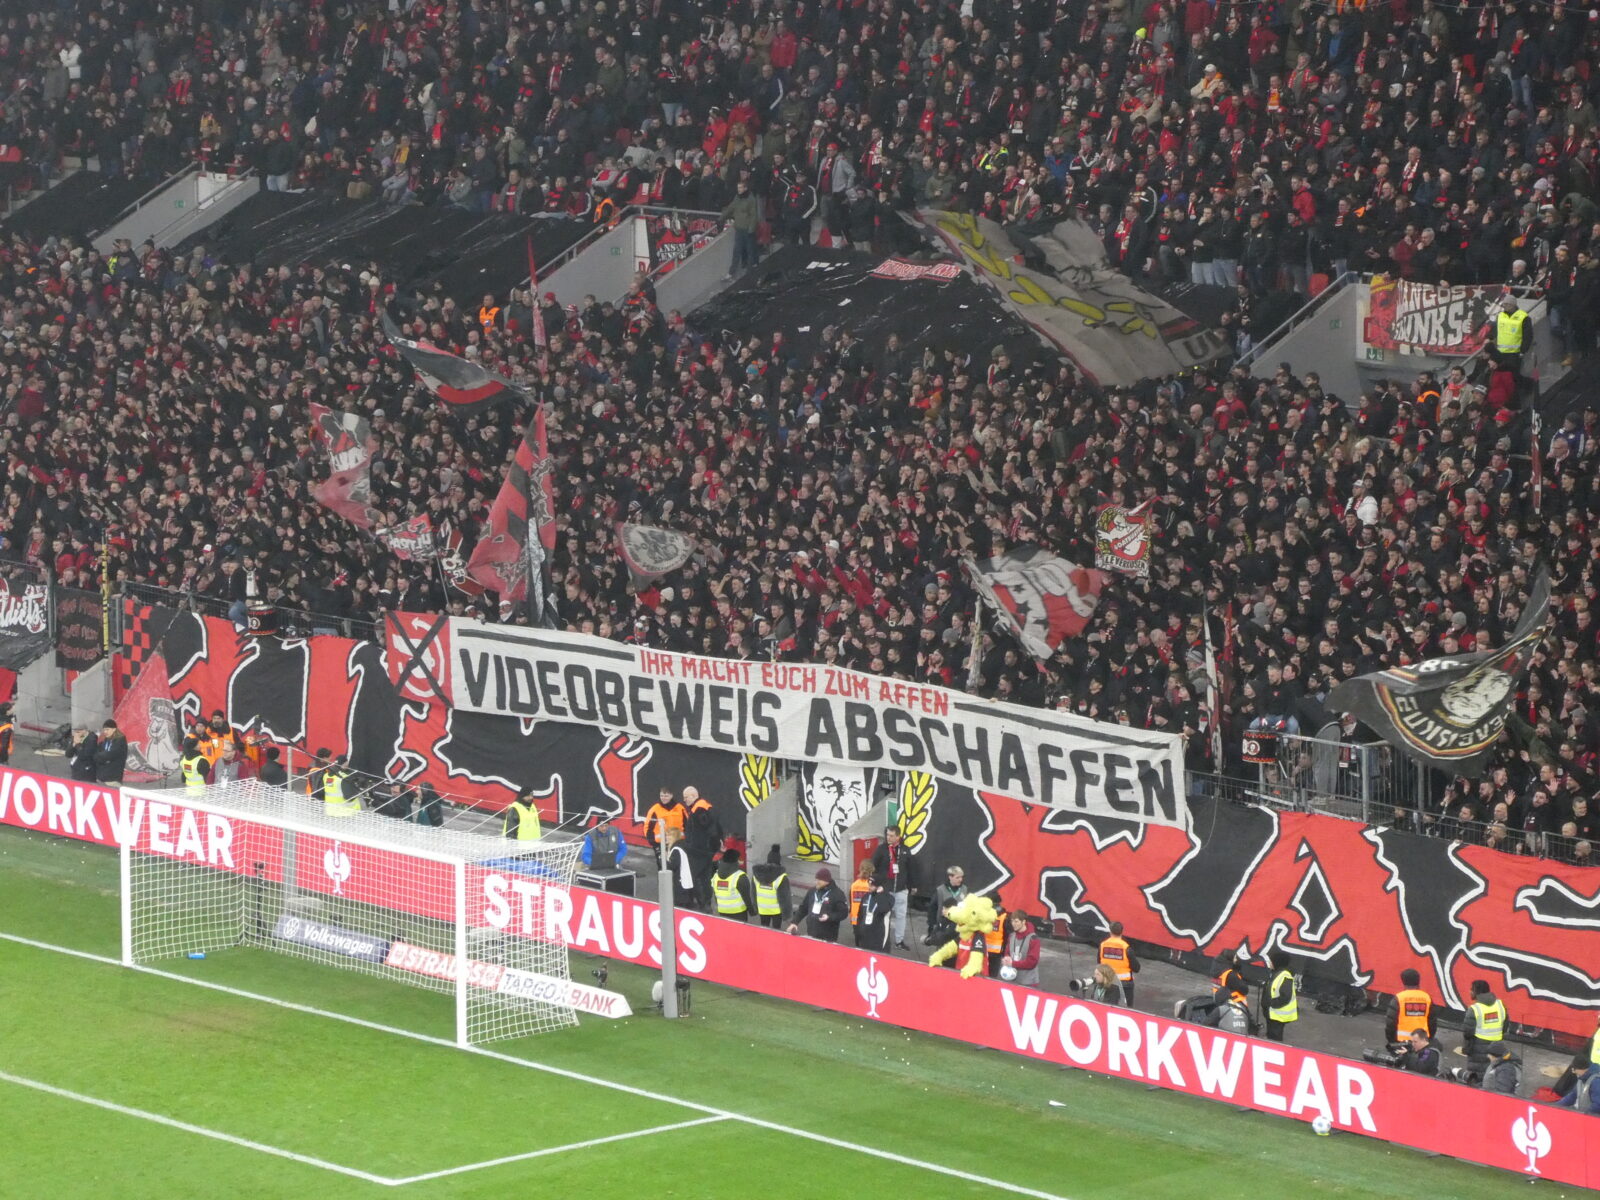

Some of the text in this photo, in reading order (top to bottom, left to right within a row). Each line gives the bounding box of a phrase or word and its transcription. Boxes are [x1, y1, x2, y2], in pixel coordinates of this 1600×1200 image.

[458, 648, 1178, 822] VIDEOBEWEIS ABSCHAFFEN
[640, 649, 949, 716] IHR MACHT EUCH ZUM AFFEN
[303, 924, 375, 956] Volkswagen
[1000, 988, 1378, 1134] WORKWEAR
